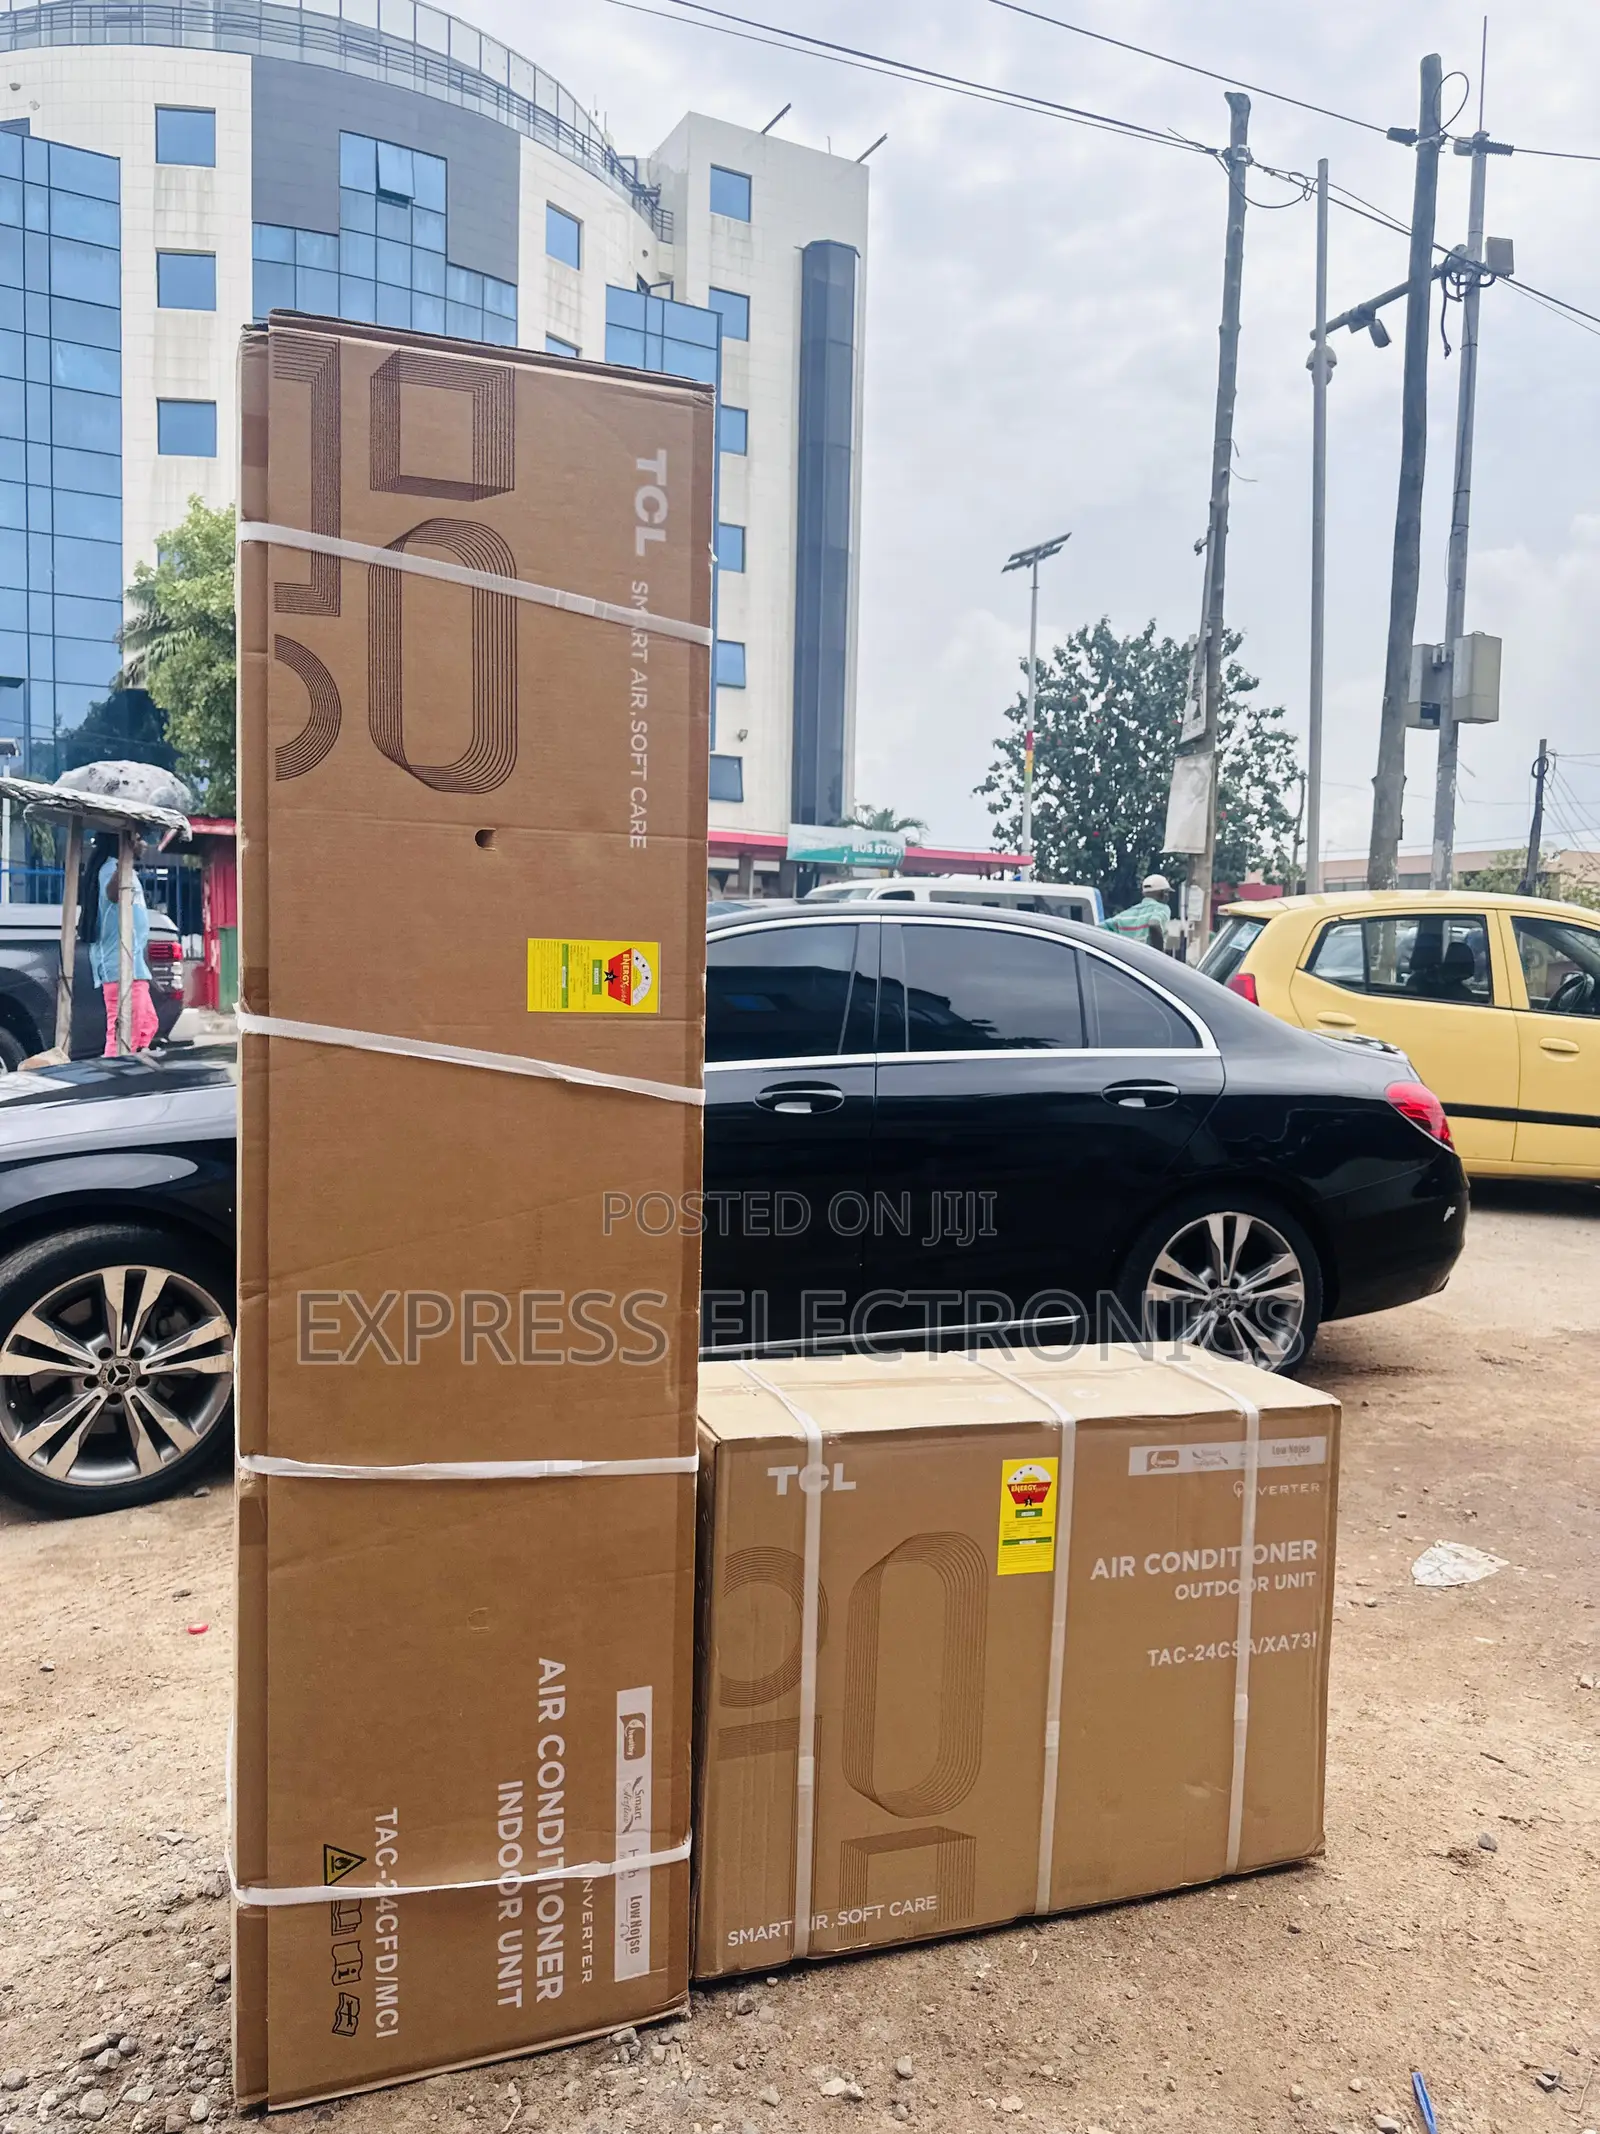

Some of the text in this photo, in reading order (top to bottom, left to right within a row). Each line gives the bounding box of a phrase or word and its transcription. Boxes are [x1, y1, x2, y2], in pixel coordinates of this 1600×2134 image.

[634, 449, 668, 556] TCL
[629, 787, 647, 848] CARE
[852, 843, 873, 854] BUS
[620, 953, 631, 986] ENERGY
[767, 1463, 856, 1495] TCL
[1010, 1483, 1038, 1494] ENERGY
[1090, 1540, 1317, 1580] AIR CONDITONER
[1275, 1571, 1317, 1591] UNIT
[634, 1788, 644, 1820] Smart
[536, 1657, 566, 2003] AIR CONDITIONER
[497, 1780, 523, 2008] INDOOR UNIT
[630, 1895, 643, 1919] Low
[727, 1920, 793, 1947] SMART
[889, 1896, 937, 1917] CARE
